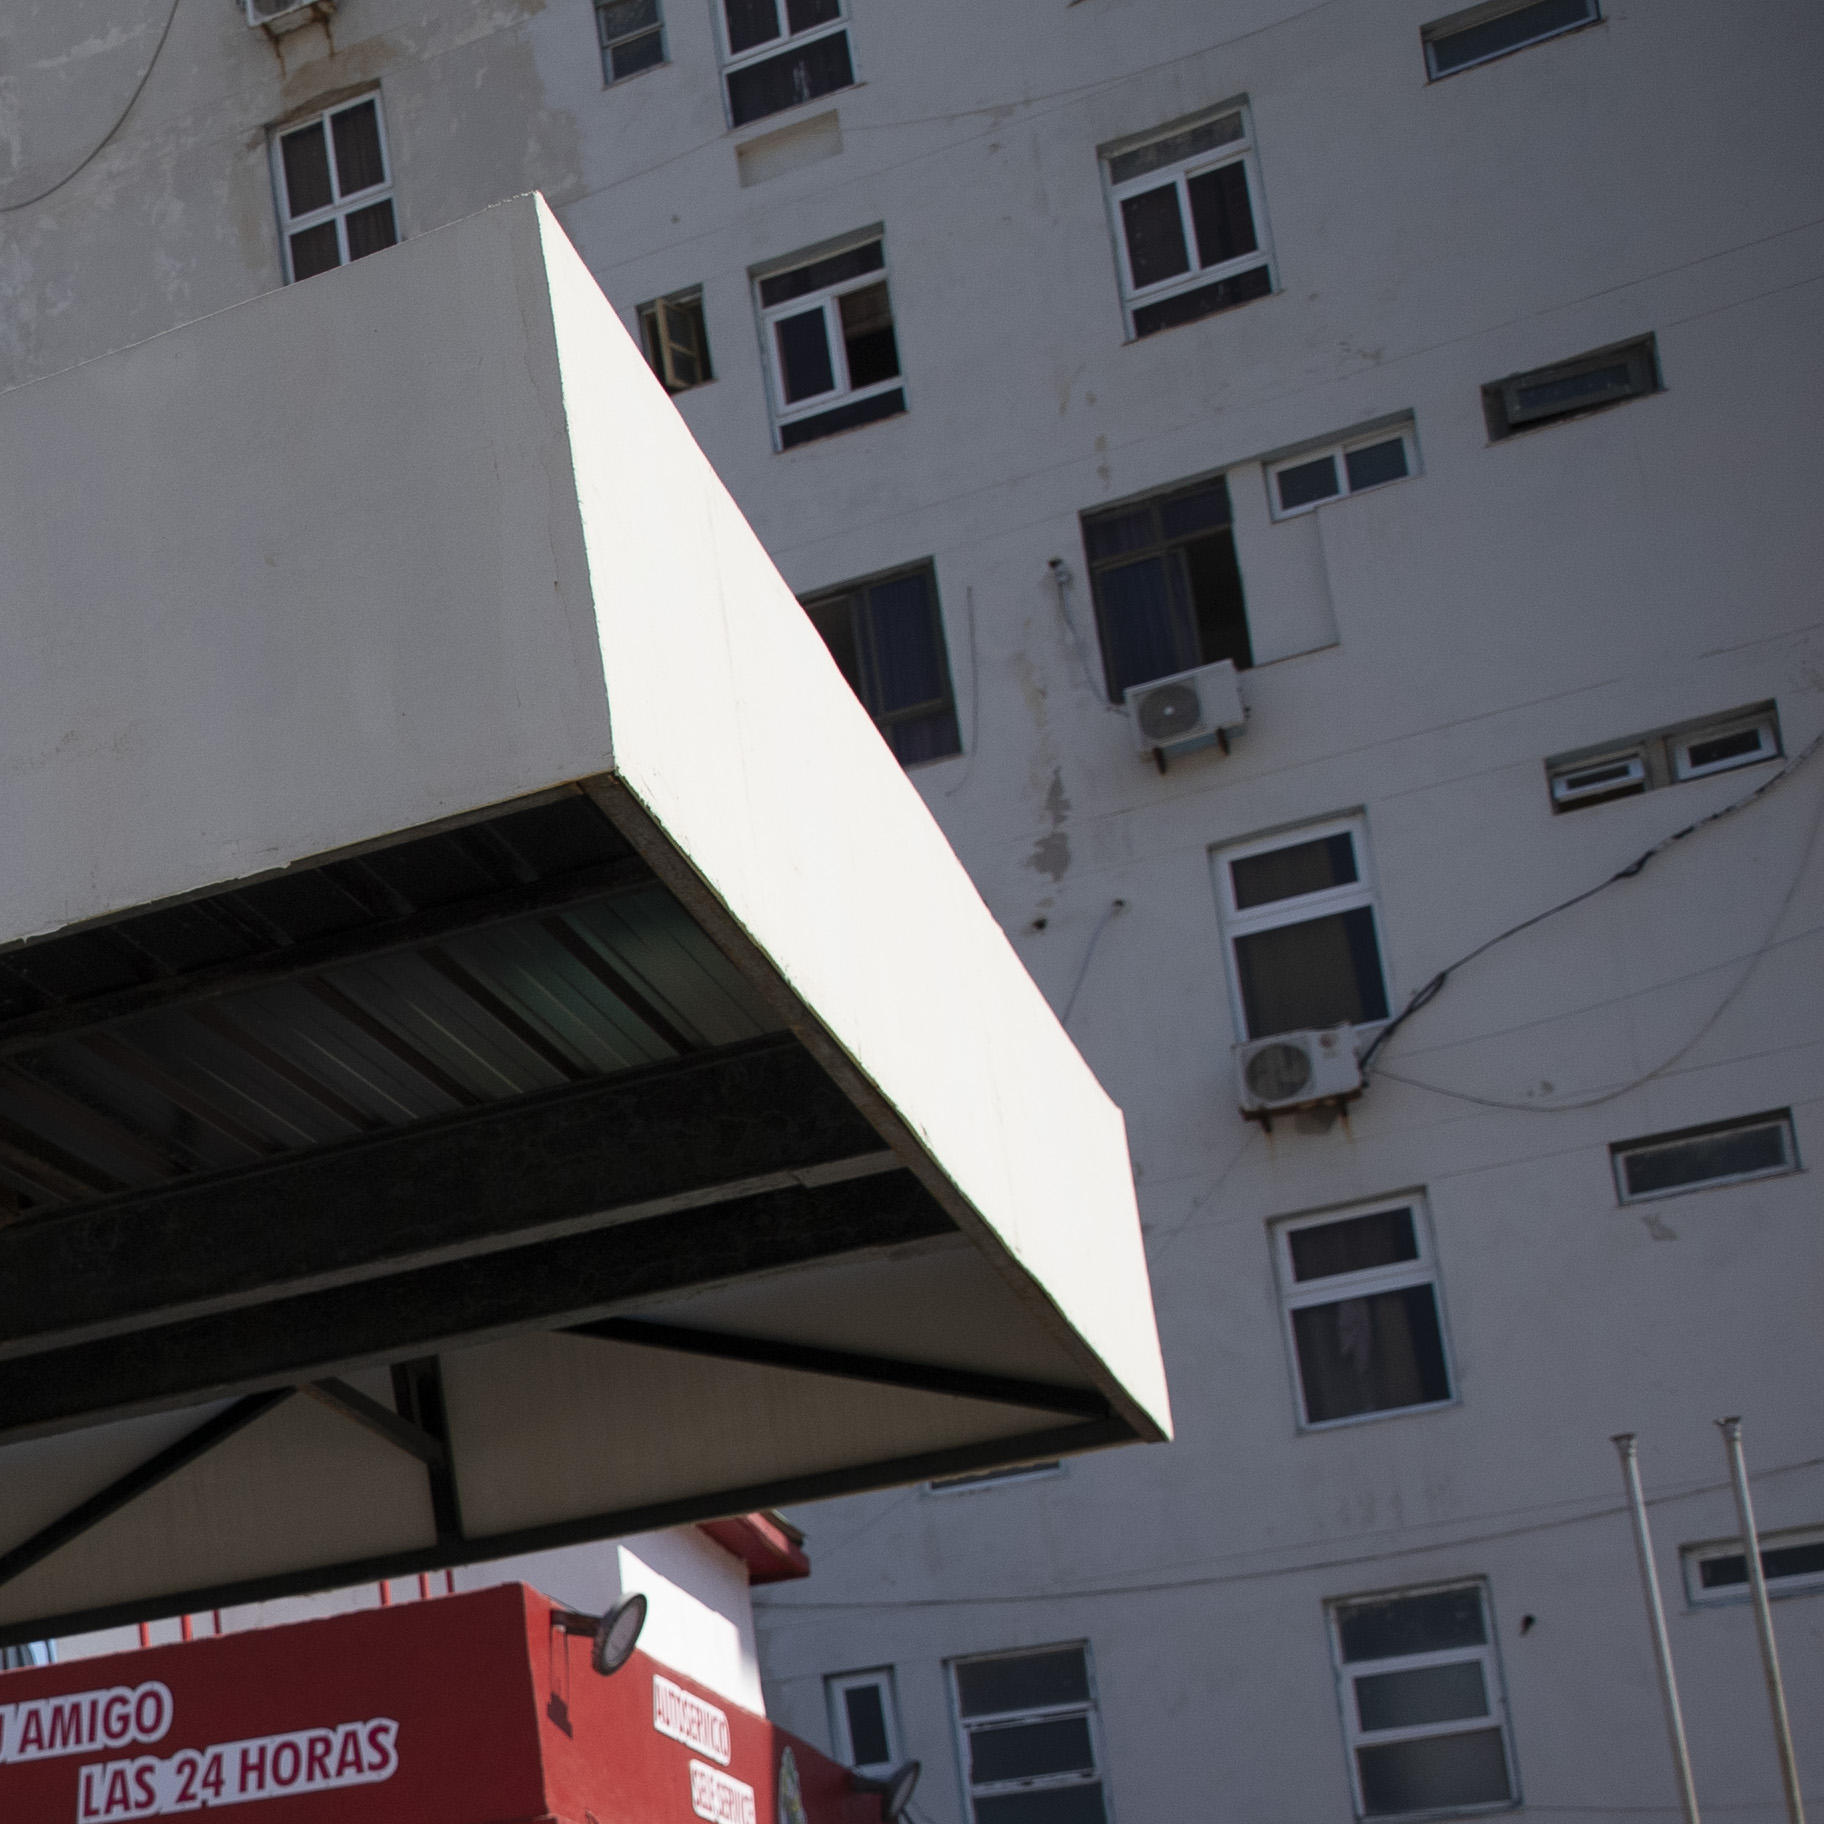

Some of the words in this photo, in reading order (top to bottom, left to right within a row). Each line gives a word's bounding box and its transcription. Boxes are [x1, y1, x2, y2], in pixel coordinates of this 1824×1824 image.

[17, 1686, 167, 1755] AMIGO
[82, 1762, 158, 1819] LAS
[176, 1753, 227, 1803] 24
[238, 1723, 393, 1797] HORAS
